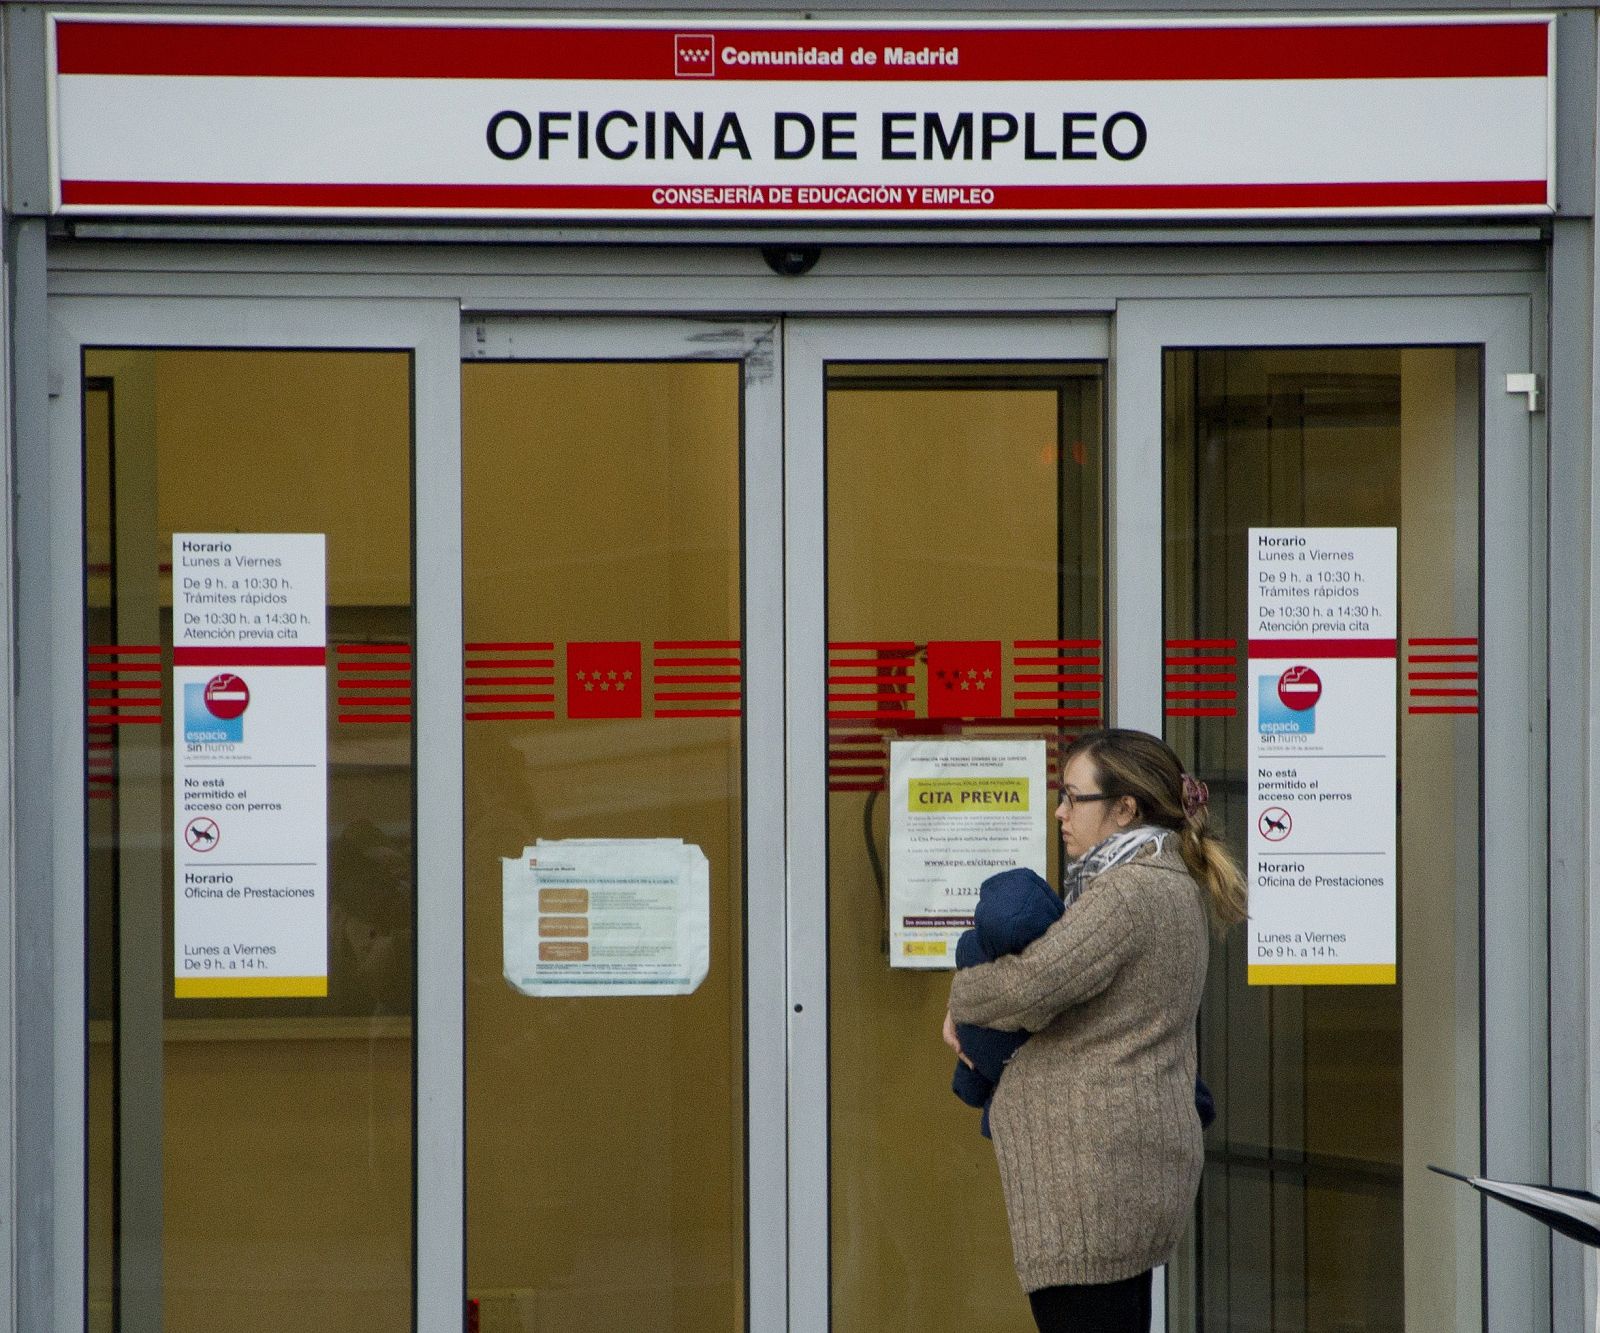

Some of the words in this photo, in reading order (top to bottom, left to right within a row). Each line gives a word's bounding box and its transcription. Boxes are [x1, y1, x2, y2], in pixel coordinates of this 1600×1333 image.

[721, 47, 843, 66] Comunidad
[850, 47, 877, 65] de
[884, 47, 959, 66] Madrid
[487, 109, 751, 161] OFICINA
[776, 110, 858, 160] DE
[883, 109, 1149, 161] EMPLEO
[652, 185, 764, 204] CONSEJERÍA
[769, 188, 791, 203] DE
[798, 185, 902, 204] EDUCACIÓN
[907, 188, 917, 203] Y
[922, 188, 994, 204] EMPLEO
[1258, 536, 1306, 546] Horario
[182, 541, 232, 552] Horario
[1258, 551, 1294, 561] Lunes
[1299, 553, 1305, 561] a
[1310, 550, 1354, 561] Viernes
[183, 557, 219, 567] Lunes
[224, 559, 231, 567] a
[235, 557, 282, 567] Viernes
[1259, 572, 1275, 583] De
[1280, 572, 1287, 583] 9
[1291, 572, 1301, 583] h.
[1306, 575, 1313, 583] a
[1318, 572, 1350, 583] 10:30
[1354, 572, 1364, 583] h.
[184, 579, 200, 589] De
[205, 579, 212, 589] 9
[216, 579, 227, 589] h.
[232, 581, 239, 589] a
[245, 578, 278, 589] 10:30
[282, 579, 292, 589] h.
[1258, 586, 1310, 597] Trámites
[1314, 586, 1359, 599] rápidos
[184, 592, 236, 603] Trámites
[241, 592, 287, 605] rápidos
[1259, 607, 1275, 617] De
[1280, 607, 1310, 617] 10:30
[1313, 607, 1323, 617] h.
[1338, 607, 1369, 617] 14:30
[1372, 607, 1381, 617] h.
[184, 614, 201, 624] De
[205, 614, 237, 624] 10:30
[240, 614, 251, 624] h.
[254, 616, 261, 624] a
[265, 614, 297, 624] 14:30
[300, 614, 310, 624] h.
[1259, 621, 1308, 632] Atención
[1312, 622, 1346, 633] previa
[1349, 621, 1369, 632] cita
[184, 628, 235, 639] Atención
[239, 629, 274, 640] previa
[277, 628, 298, 639] cita
[1261, 721, 1299, 733] espacio
[187, 731, 227, 741] espacio
[1261, 734, 1276, 743] sin
[1278, 734, 1307, 743] humo
[187, 743, 202, 752] sin
[205, 743, 235, 752] humo
[1258, 769, 1272, 777] No
[1276, 769, 1297, 777] está
[185, 779, 199, 787] No
[202, 778, 225, 787] está
[1258, 781, 1306, 789] permitido
[1310, 781, 1319, 789] el
[184, 791, 234, 799] permitido
[238, 790, 247, 798] el
[919, 792, 953, 804] CITA
[961, 791, 1020, 804] PREVIA
[1258, 793, 1294, 801] acceso
[1319, 793, 1352, 802] perros
[184, 803, 222, 811] acceso
[225, 803, 245, 811] con
[248, 803, 281, 811] perros
[924, 858, 1016, 867] www.sepe.es/citaprevia
[1258, 862, 1305, 872] Horario
[185, 873, 233, 883] Horario
[1258, 876, 1295, 887] Oficina
[1299, 876, 1312, 886] de
[1315, 876, 1384, 886] Prestaciones
[185, 888, 223, 898] Oficina
[227, 888, 240, 898] de
[244, 887, 315, 898] Prestaciones
[945, 888, 954, 896] 91
[958, 888, 972, 896] 272
[1258, 932, 1292, 943] Lunes
[1295, 935, 1301, 943] a
[1305, 932, 1346, 943] Viernes
[185, 944, 220, 955] Lunes
[223, 946, 230, 955] a
[233, 944, 276, 955] Viernes
[1258, 947, 1273, 957] De
[1276, 947, 1283, 957] 9
[1287, 947, 1297, 957] h.
[1301, 949, 1307, 957] a
[1312, 947, 1324, 957] 14
[1328, 947, 1338, 957] h.
[185, 959, 201, 970] De
[204, 959, 212, 970] 9
[215, 959, 225, 970] h.
[229, 962, 236, 970] a
[241, 959, 253, 969] 14
[258, 959, 268, 970] h.
